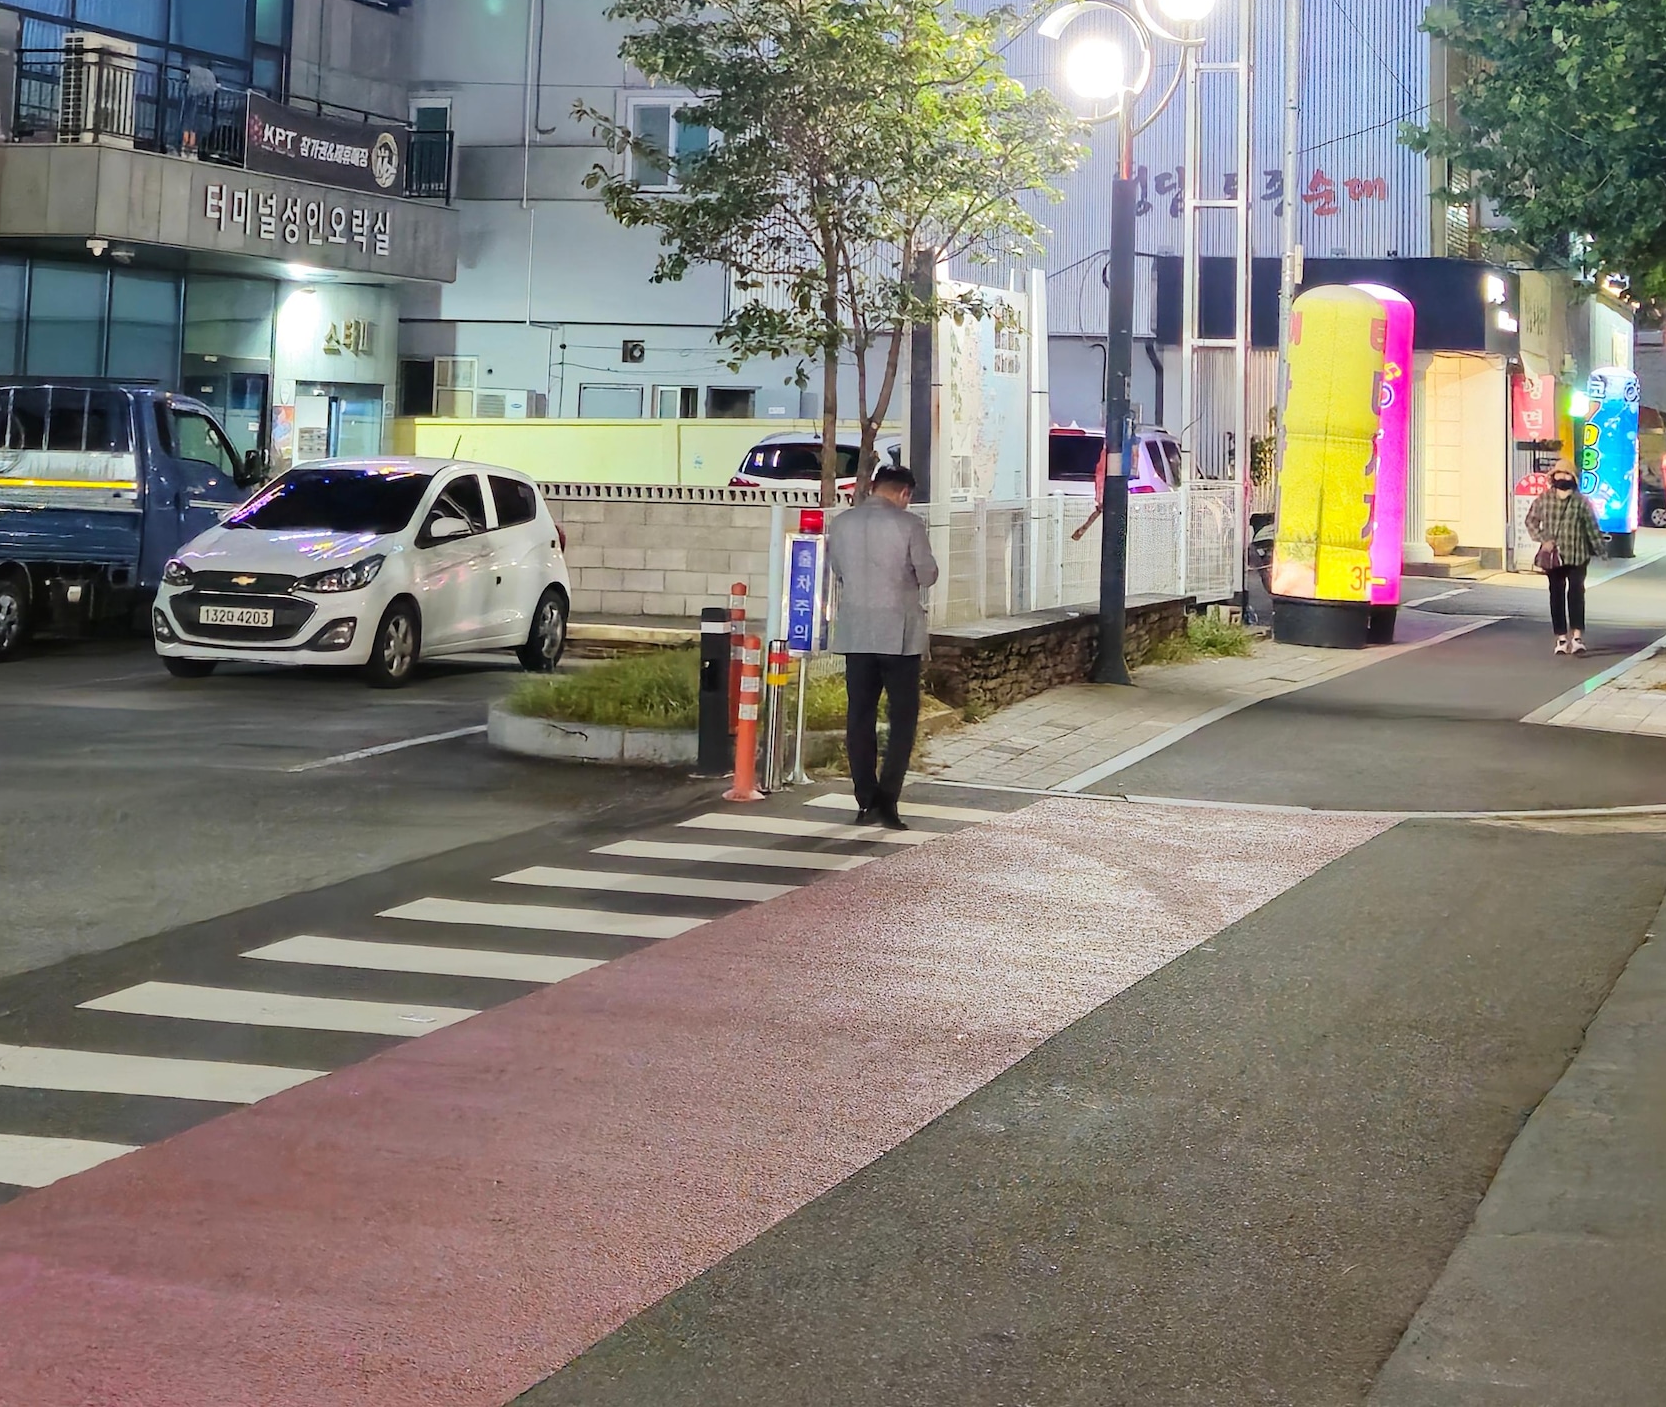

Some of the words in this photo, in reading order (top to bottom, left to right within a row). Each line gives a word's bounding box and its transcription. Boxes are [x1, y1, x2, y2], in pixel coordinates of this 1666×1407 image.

[263, 123, 298, 150] KPT
[1301, 168, 1388, 217] 순대
[206, 184, 392, 257] 터미널성인오락실
[237, 610, 269, 626] 4203
